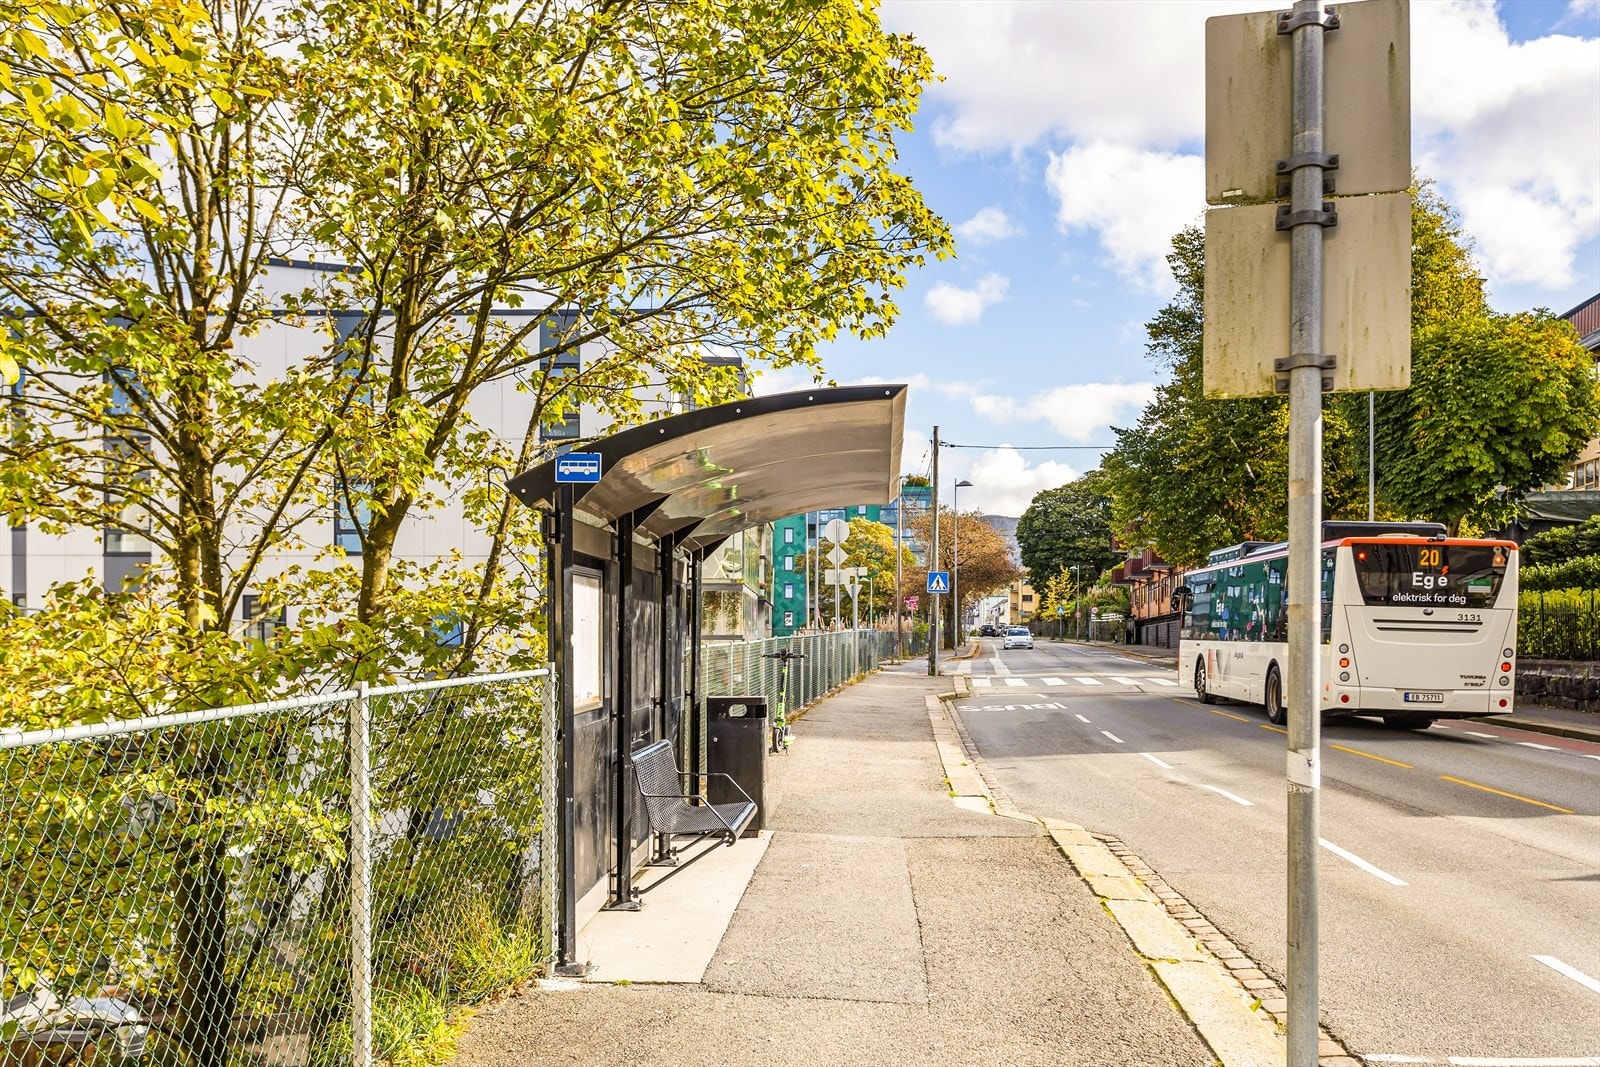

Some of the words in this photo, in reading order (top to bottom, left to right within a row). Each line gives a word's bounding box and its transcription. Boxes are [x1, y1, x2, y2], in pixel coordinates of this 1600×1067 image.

[1420, 549, 1440, 567] 20
[1412, 571, 1435, 589] Eg
[1392, 592, 1432, 603] elektrisk
[1434, 593, 1447, 603] for
[1448, 594, 1466, 604] deg
[1457, 613, 1482, 622] 3131
